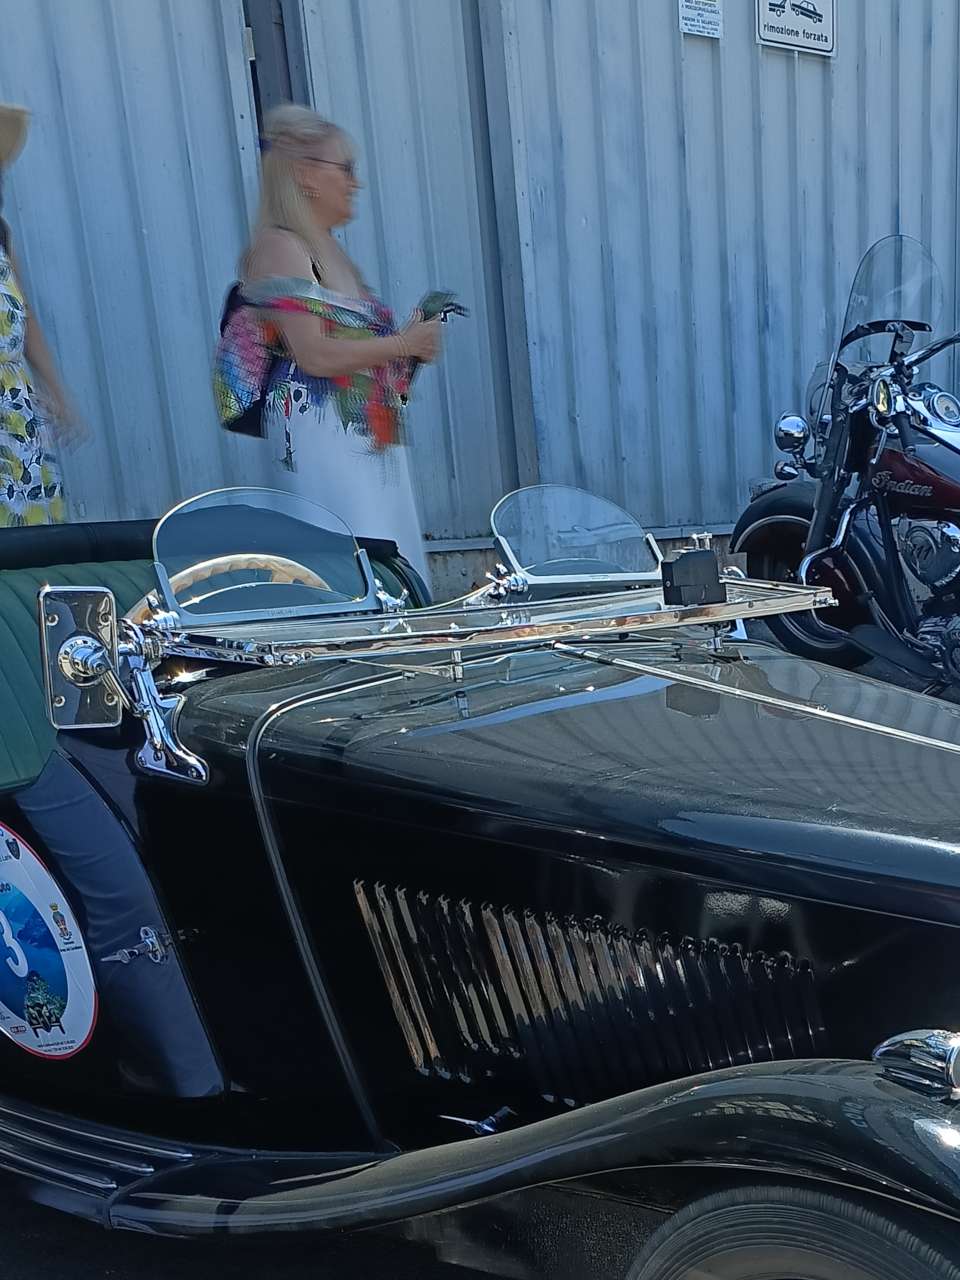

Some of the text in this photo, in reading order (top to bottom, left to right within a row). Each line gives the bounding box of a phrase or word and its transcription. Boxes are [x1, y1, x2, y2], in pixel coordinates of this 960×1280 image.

[763, 22, 829, 43] rimozione forzata
[871, 470, 934, 497] Indian
